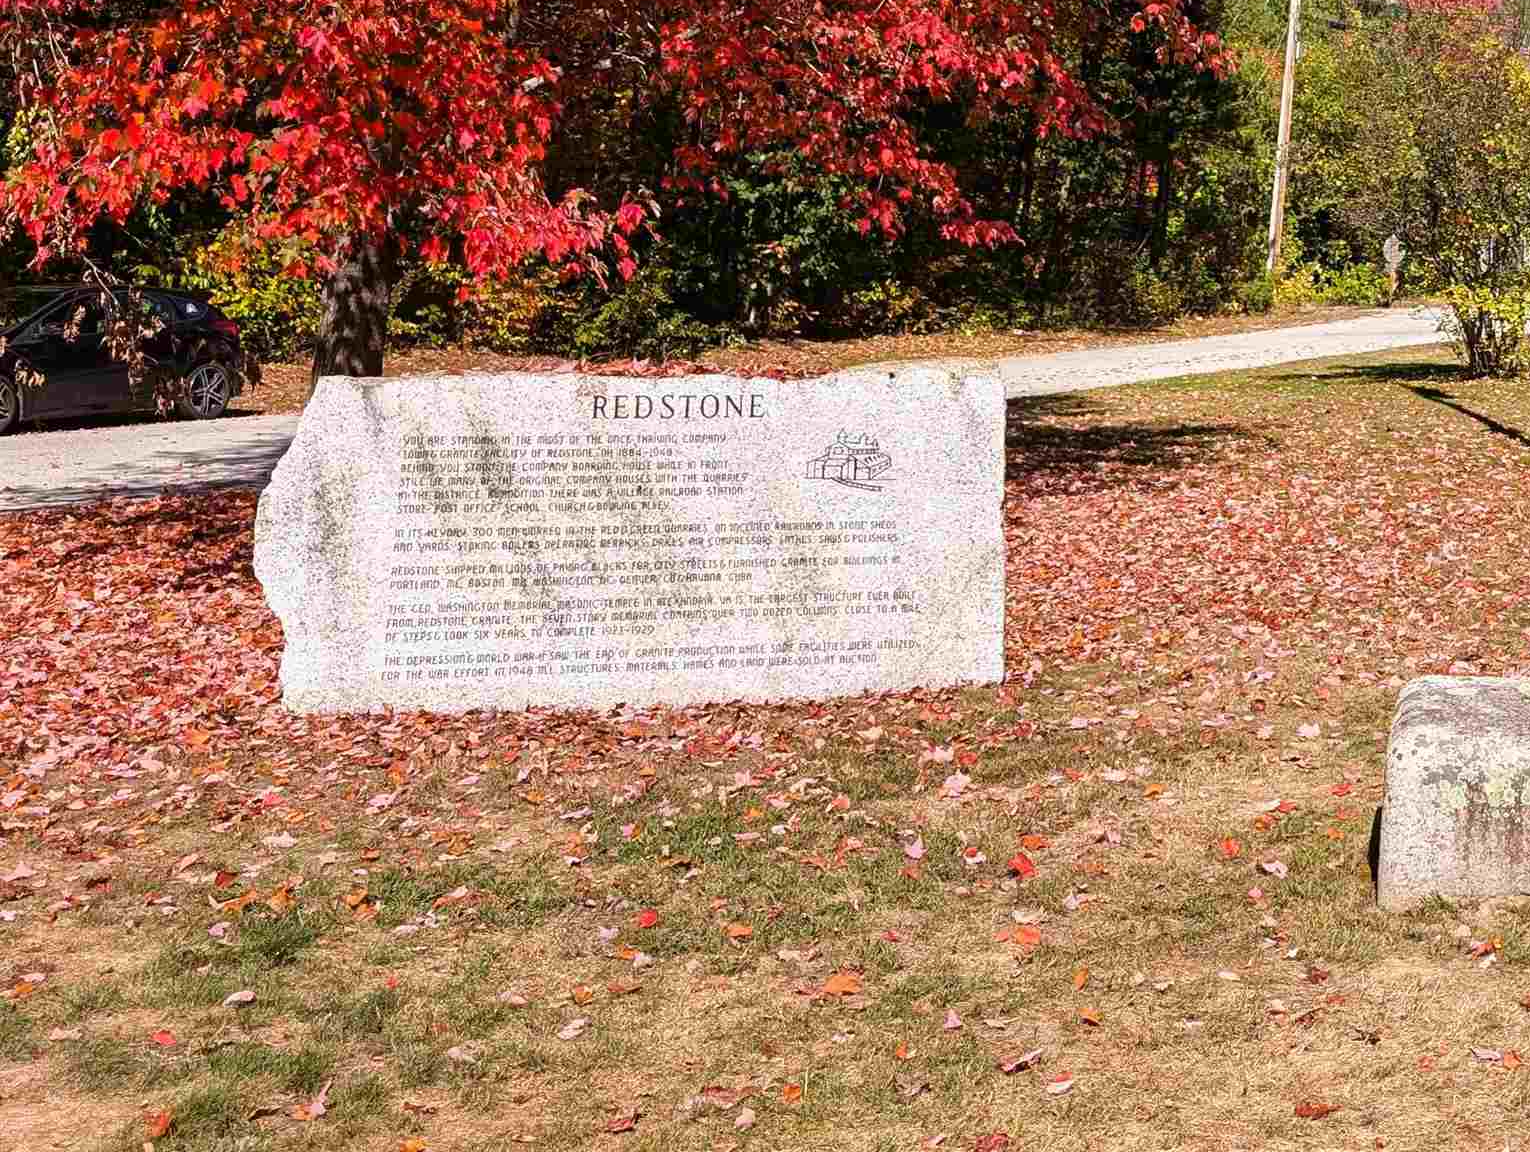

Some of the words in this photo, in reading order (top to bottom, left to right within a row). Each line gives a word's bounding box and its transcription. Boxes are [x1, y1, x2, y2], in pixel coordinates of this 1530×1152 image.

[591, 394, 764, 419] REDSTONE
[428, 436, 445, 446] ARE
[517, 436, 532, 445] THE
[569, 435, 580, 444] OF
[587, 435, 602, 444] THE
[472, 528, 493, 537] 300
[473, 631, 489, 640] SIX
[384, 656, 401, 665] THE
[380, 671, 400, 681] FOR
[405, 670, 423, 680] THE
